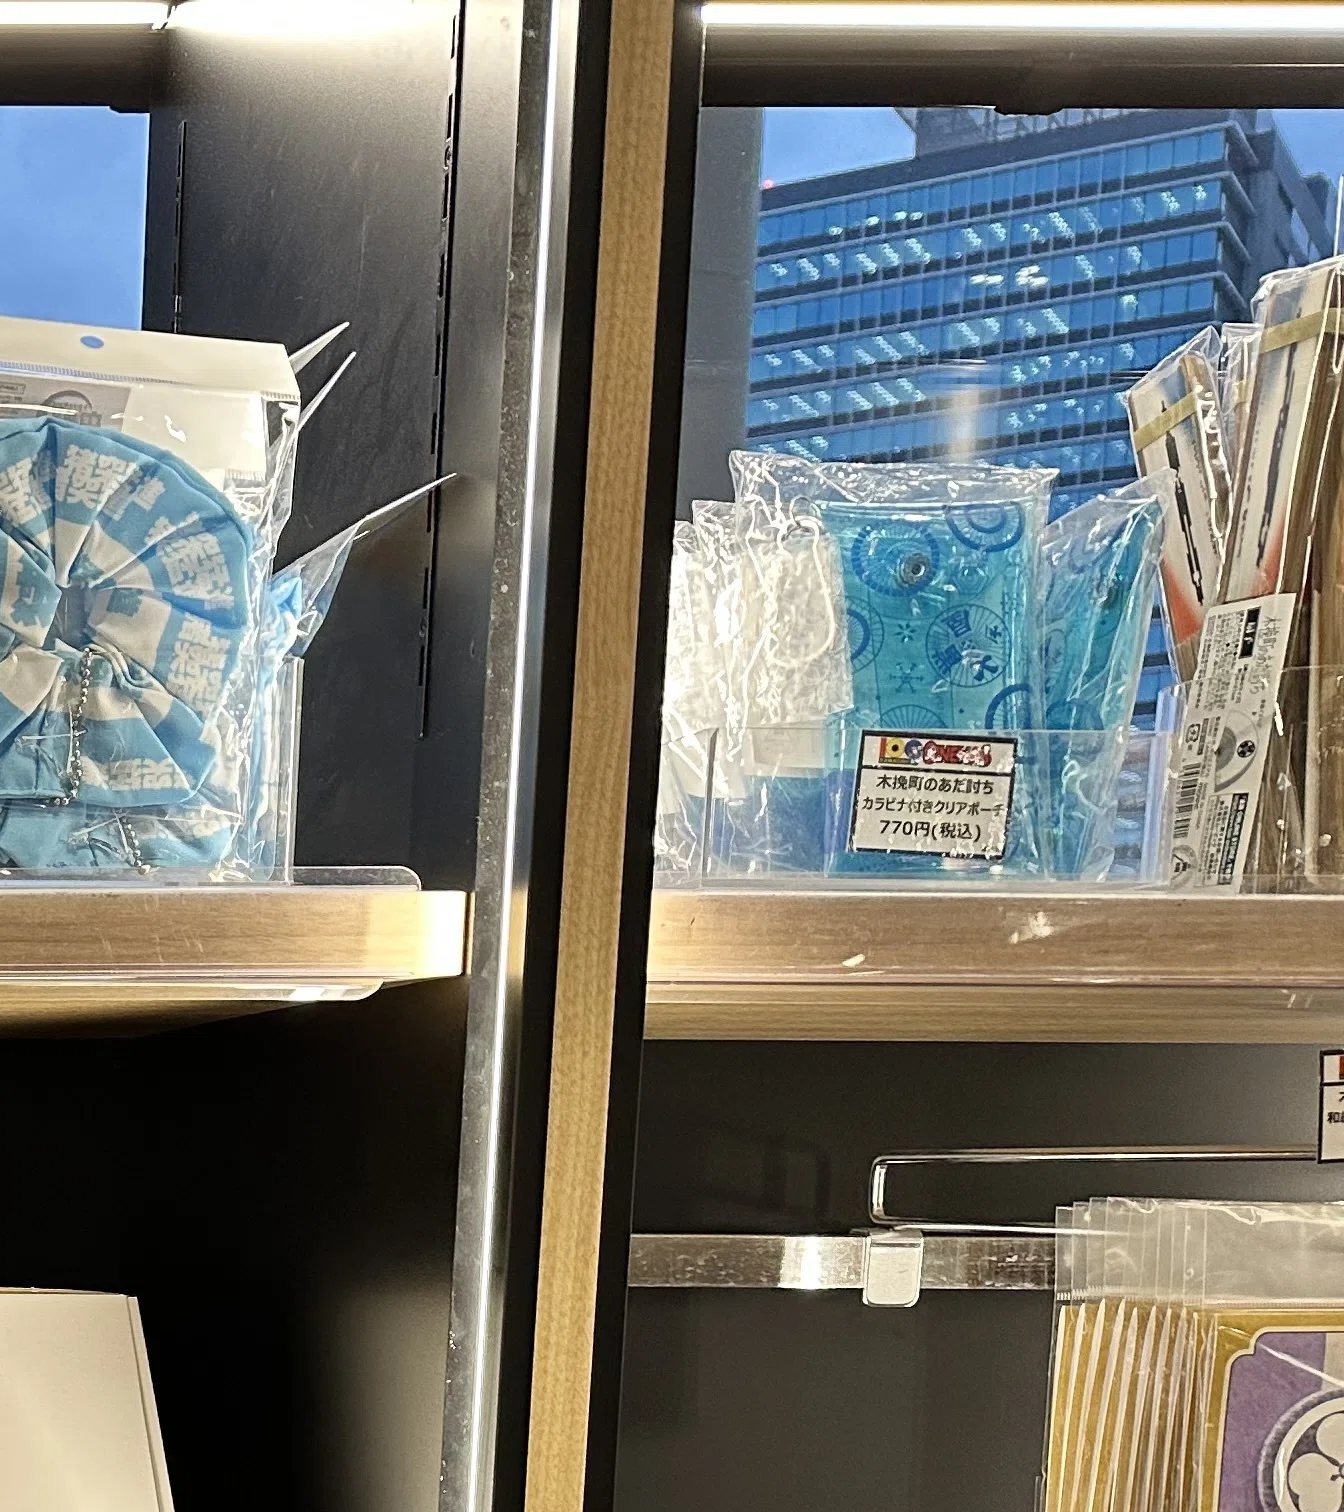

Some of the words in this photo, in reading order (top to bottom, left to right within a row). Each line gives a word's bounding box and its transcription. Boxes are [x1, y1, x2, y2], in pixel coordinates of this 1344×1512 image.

[876, 774, 995, 795] 木挽町のあだ討ち
[862, 796, 1005, 816] カラビナ付きクリアポーチ
[879, 820, 981, 843] 770円(税込)
